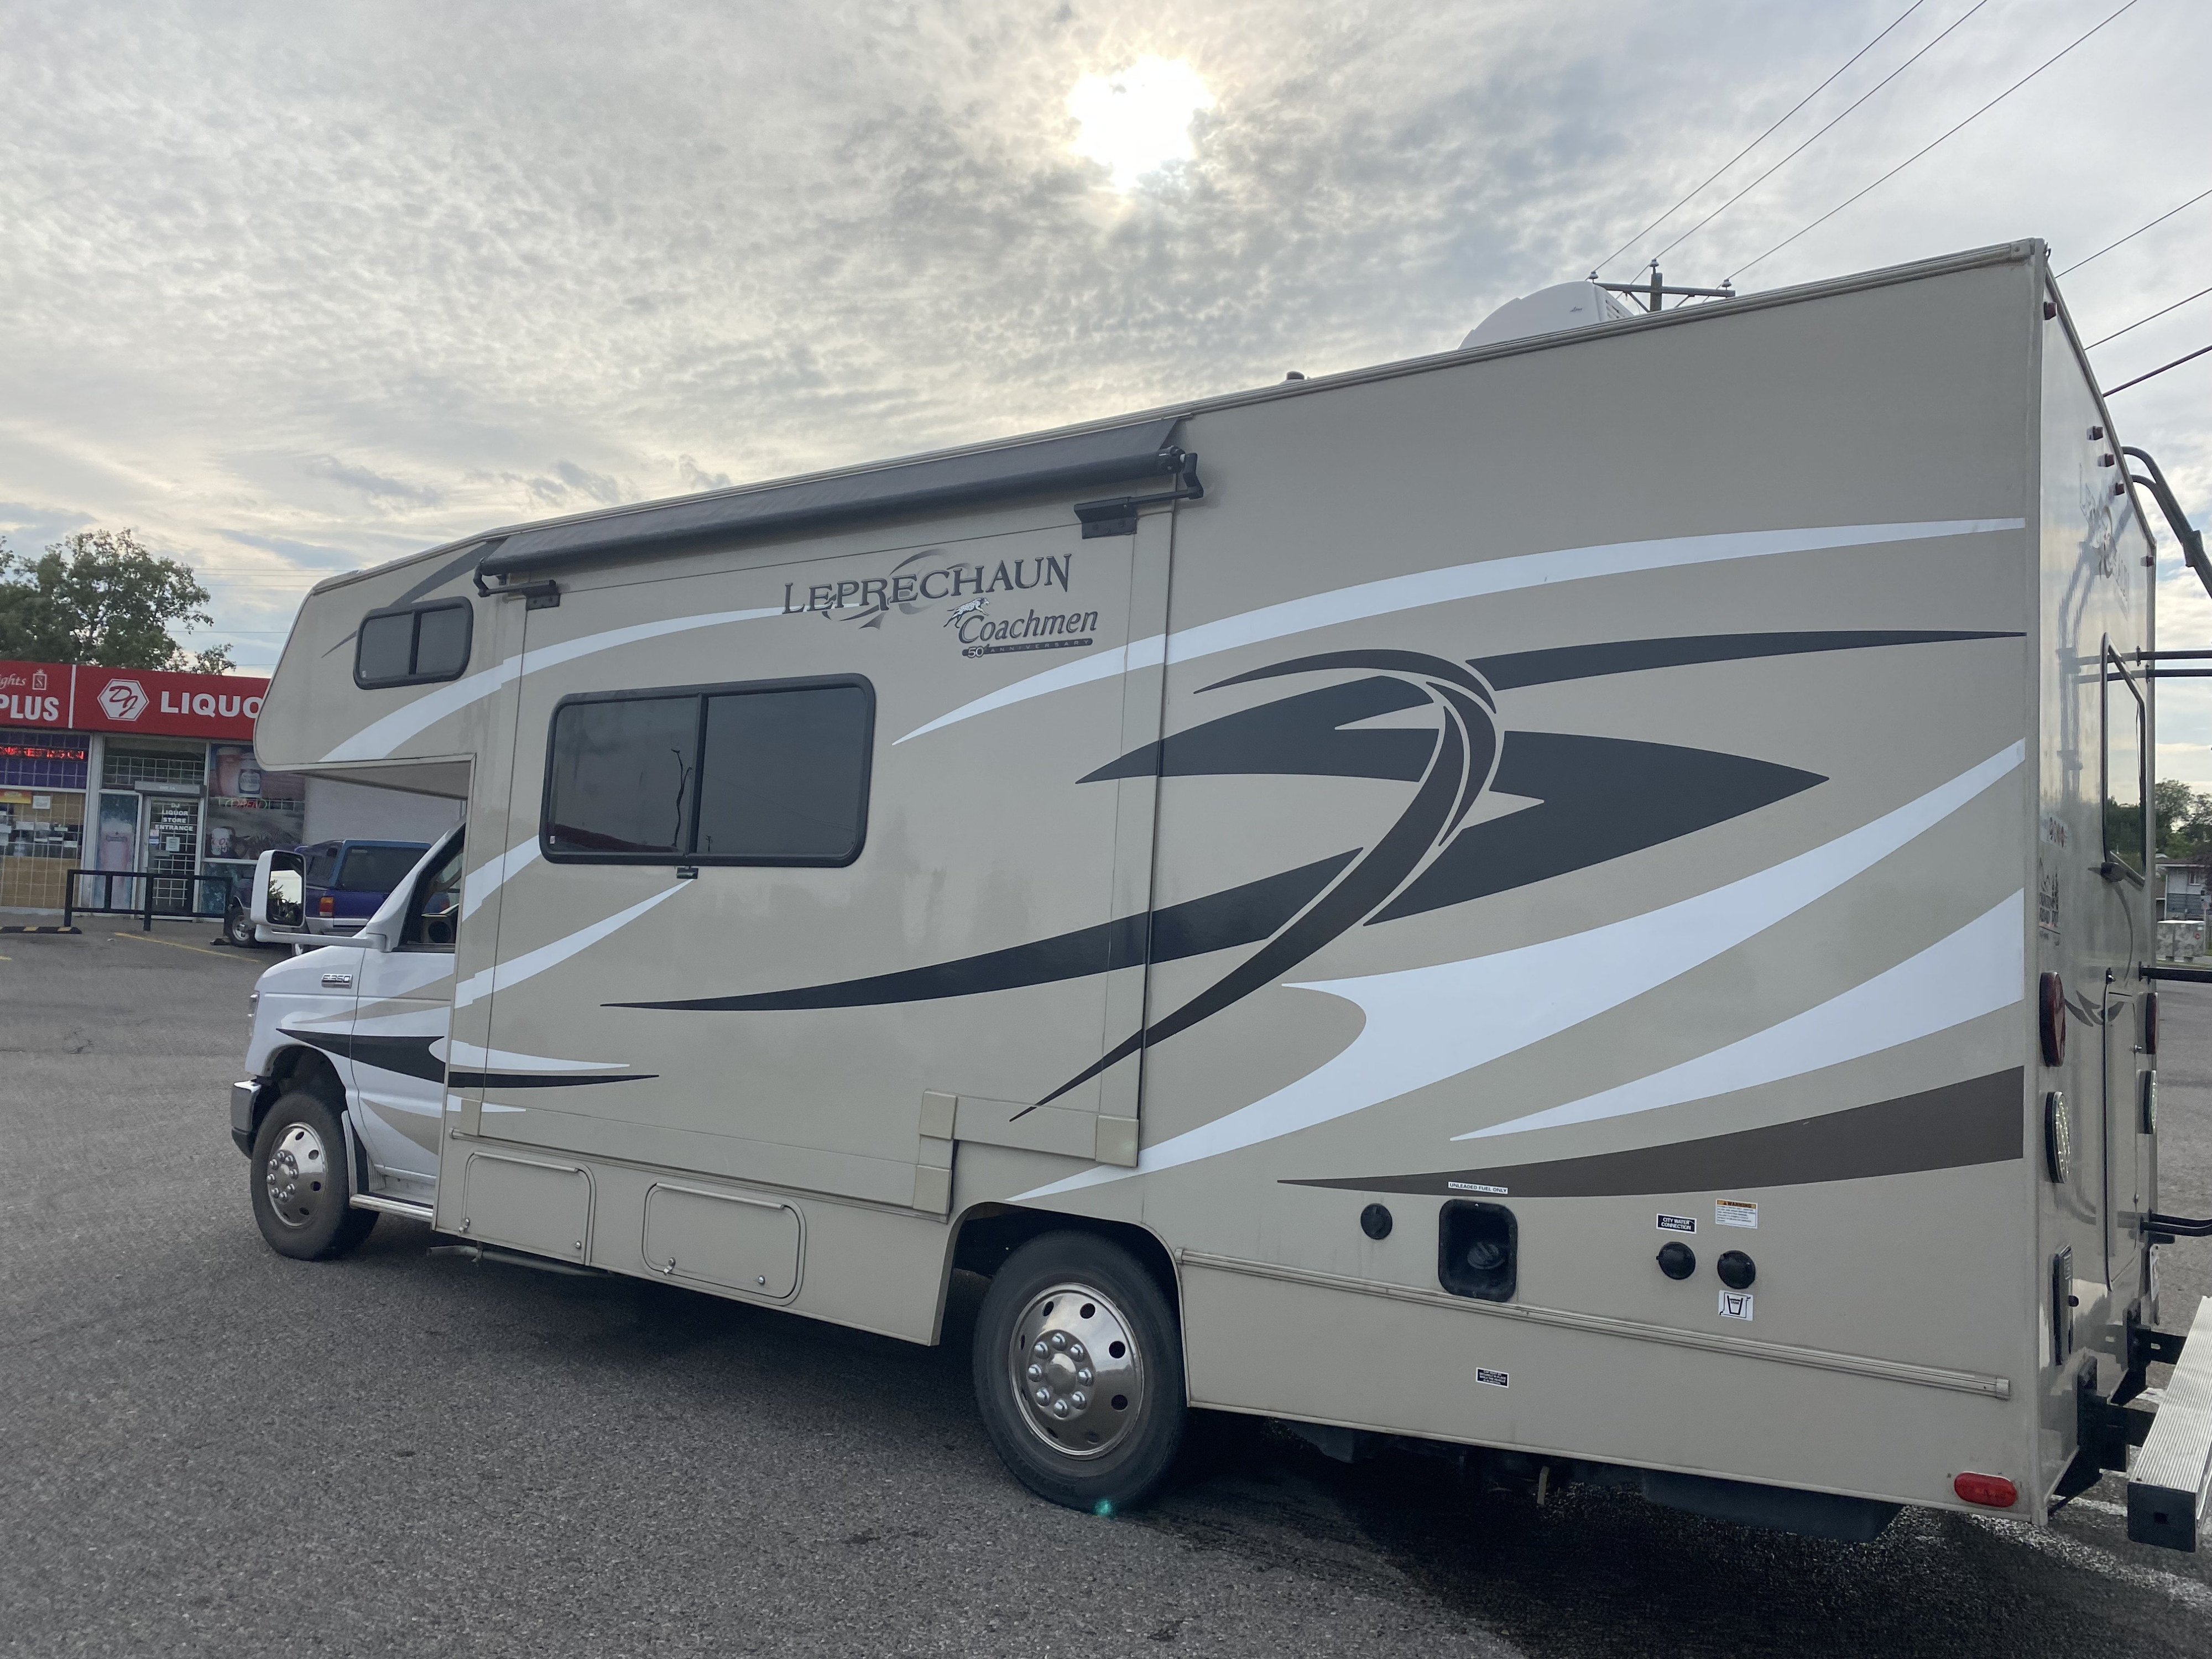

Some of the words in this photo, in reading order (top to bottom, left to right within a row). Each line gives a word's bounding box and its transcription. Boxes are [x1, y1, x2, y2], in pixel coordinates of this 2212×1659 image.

[782, 554, 1072, 614] LEPRECHAUN
[959, 609, 1098, 644] Coachmen
[990, 639, 1089, 653] ANNIVERSARY
[1661, 1222, 1691, 1230] CONNECTION
